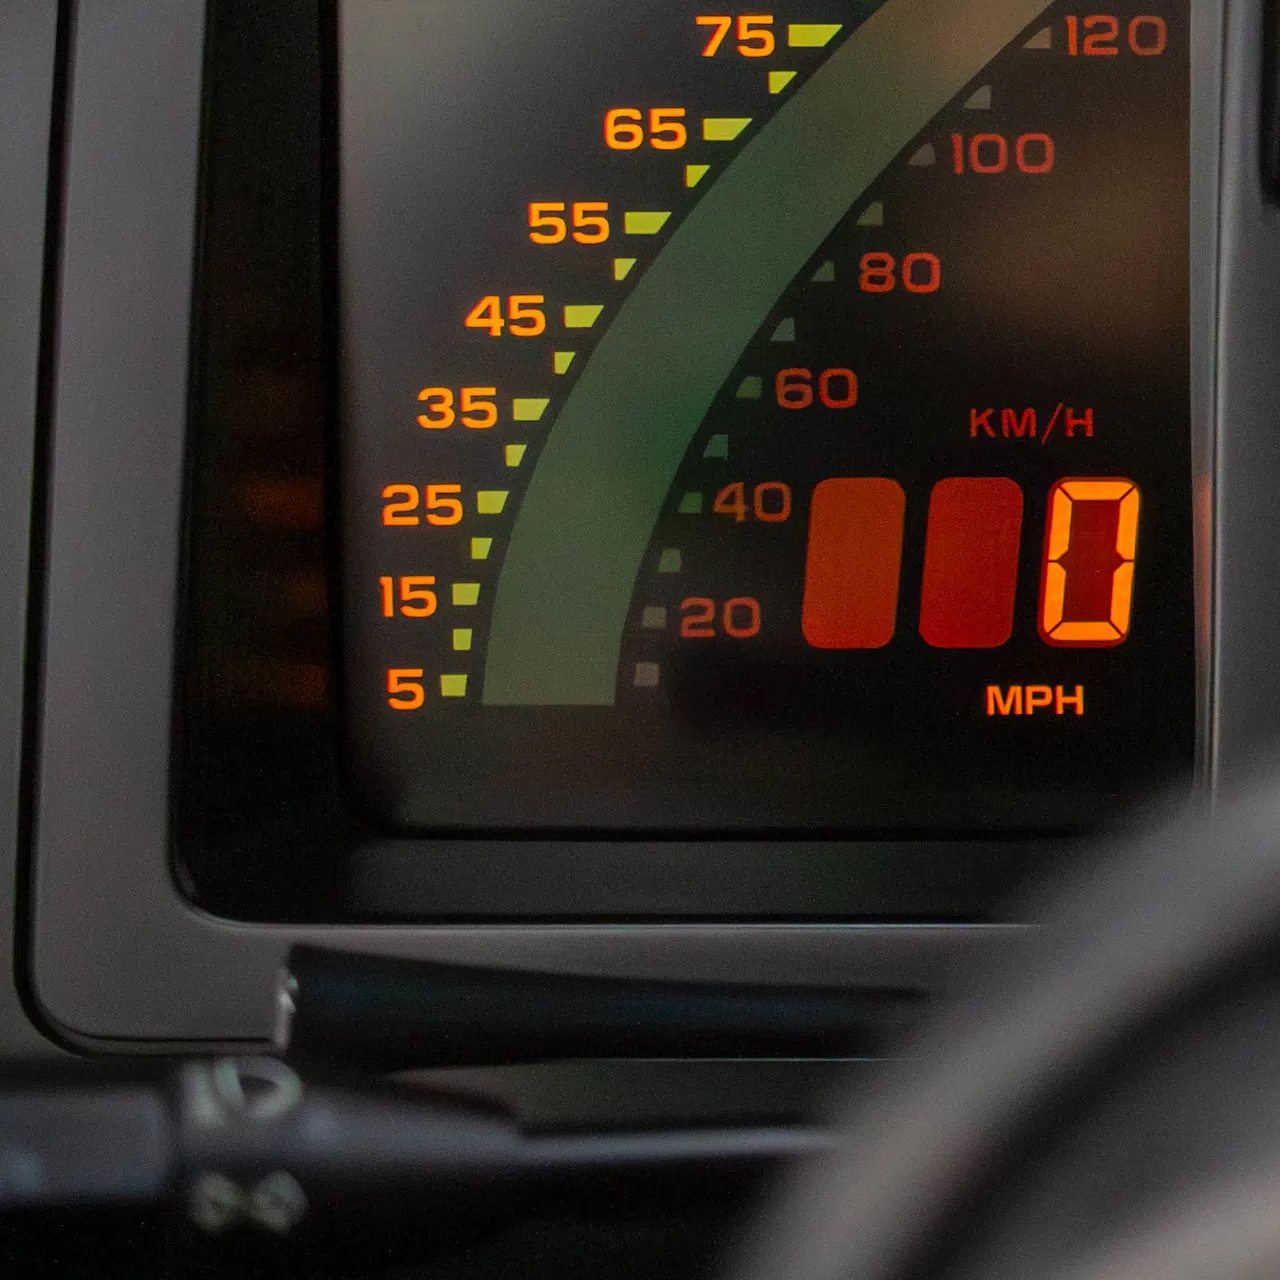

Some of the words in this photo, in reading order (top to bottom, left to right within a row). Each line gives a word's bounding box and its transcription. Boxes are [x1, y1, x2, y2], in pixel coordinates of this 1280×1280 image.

[695, 15, 776, 57] 75
[1065, 14, 1167, 56] 120
[603, 107, 687, 150] 65
[951, 132, 1055, 175] 100
[528, 201, 611, 244] 55
[858, 252, 941, 293] 80
[464, 295, 546, 337] 45
[416, 386, 498, 429] 35
[775, 367, 858, 409] 60
[969, 402, 1095, 445] KM/H
[381, 483, 463, 526] 25
[712, 481, 792, 522] 40
[1043, 481, 1140, 641] 0
[379, 576, 437, 618] 15
[679, 596, 761, 638] 20
[387, 668, 425, 710] 5
[985, 685, 1085, 715] MPH
